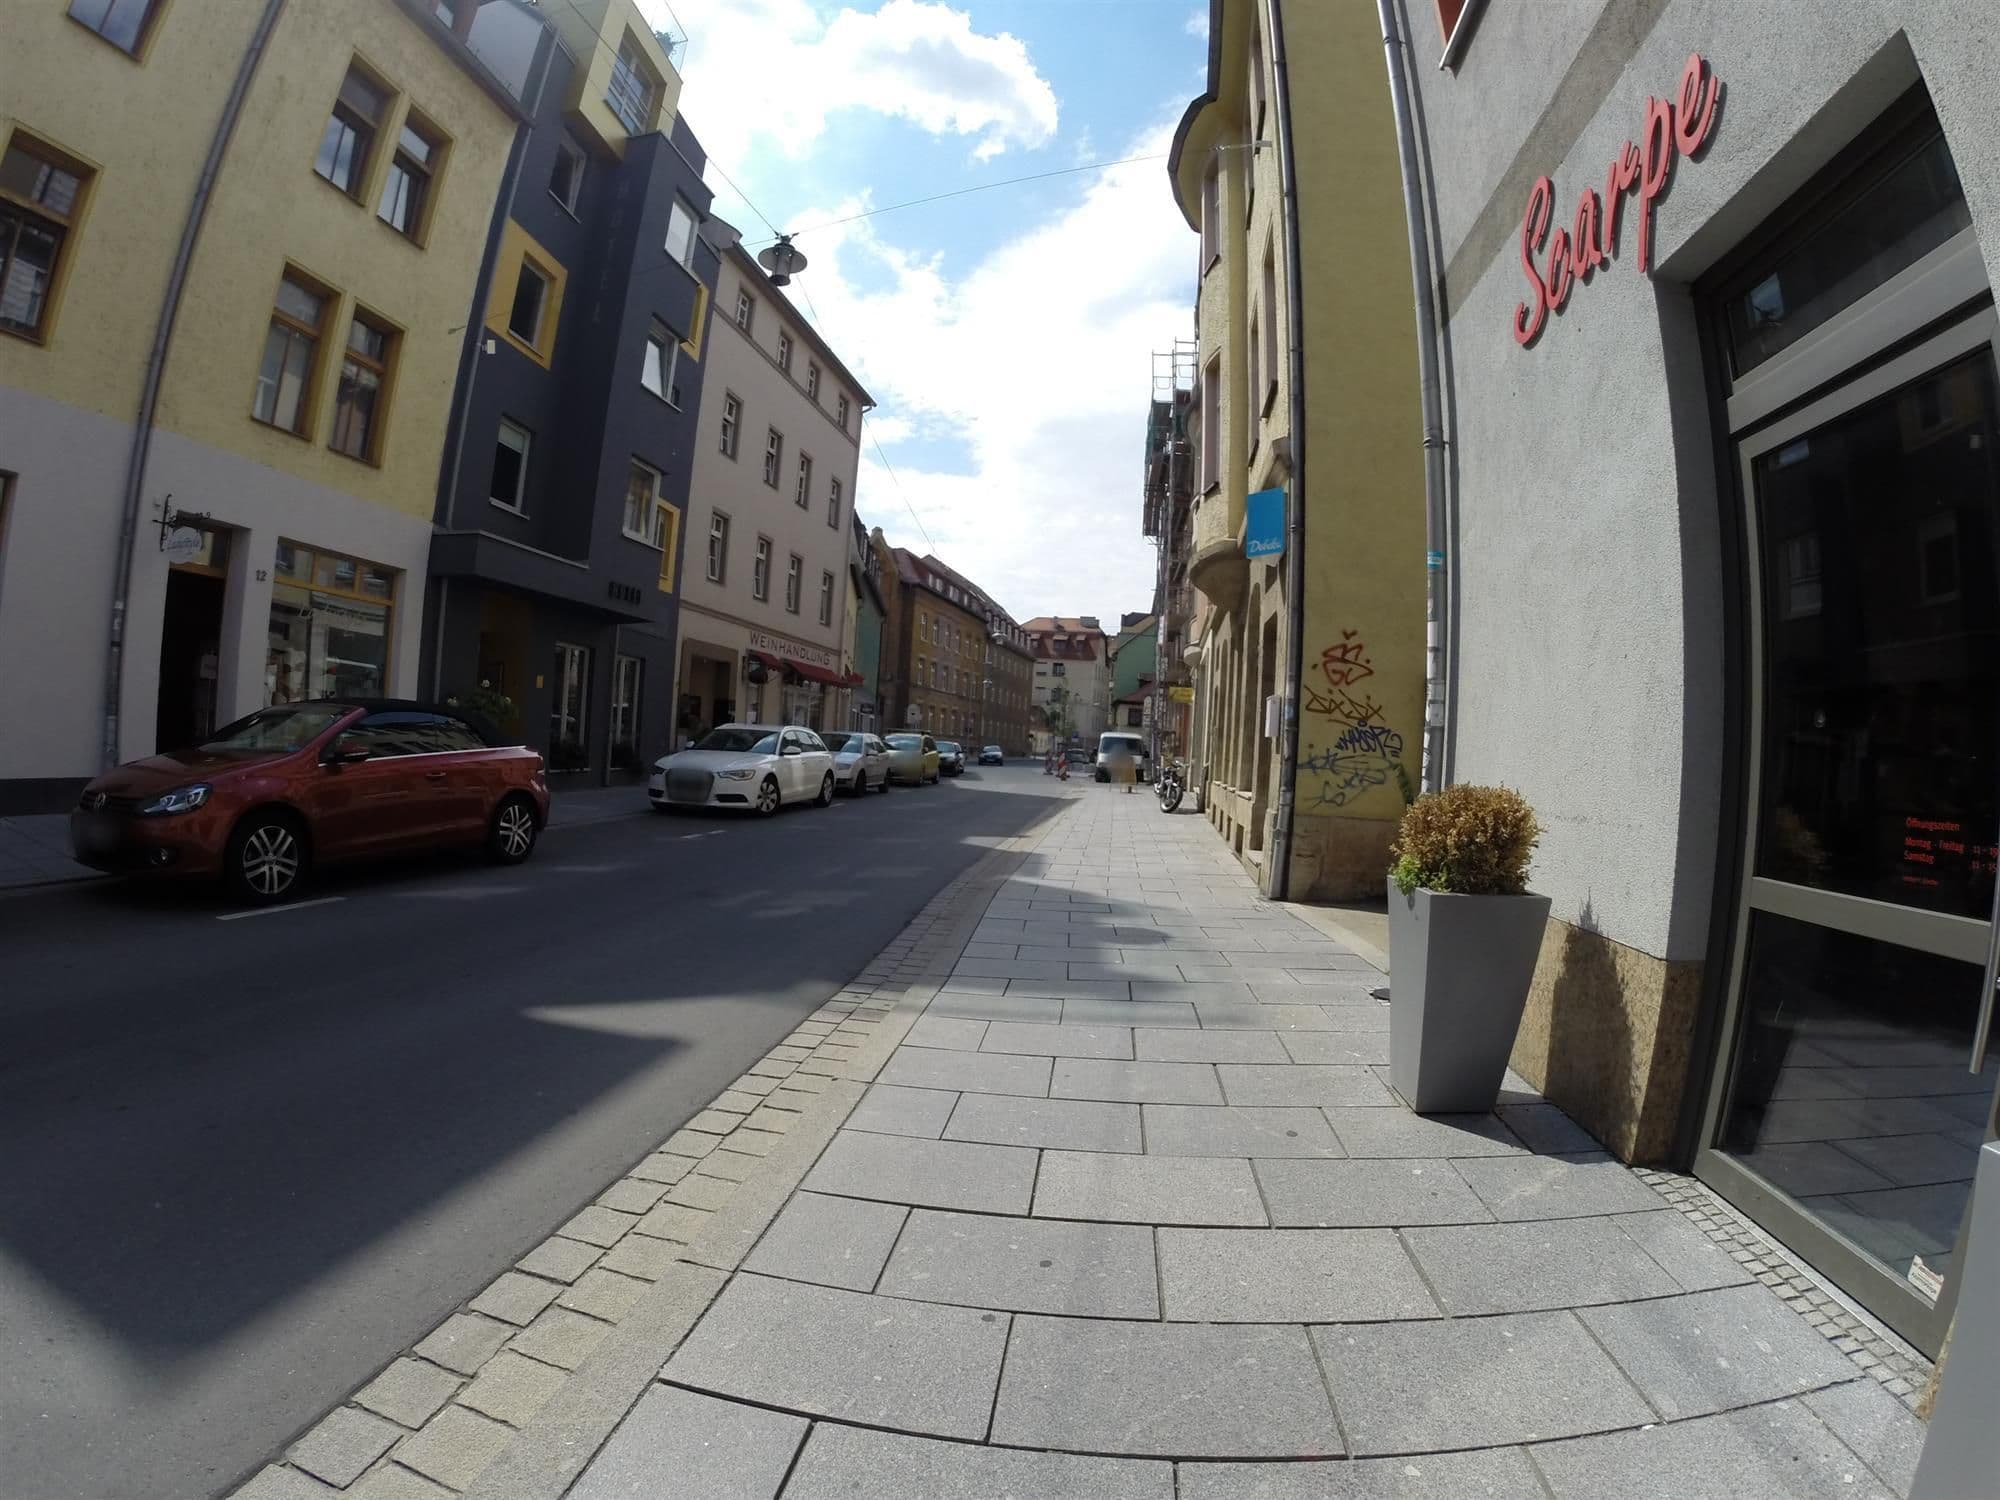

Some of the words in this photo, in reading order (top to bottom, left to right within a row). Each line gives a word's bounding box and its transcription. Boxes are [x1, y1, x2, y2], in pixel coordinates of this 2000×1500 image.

[1513, 52, 1720, 346] Scarpe
[255, 569, 268, 582] 12
[750, 631, 832, 665] WEINHANDLUNG
